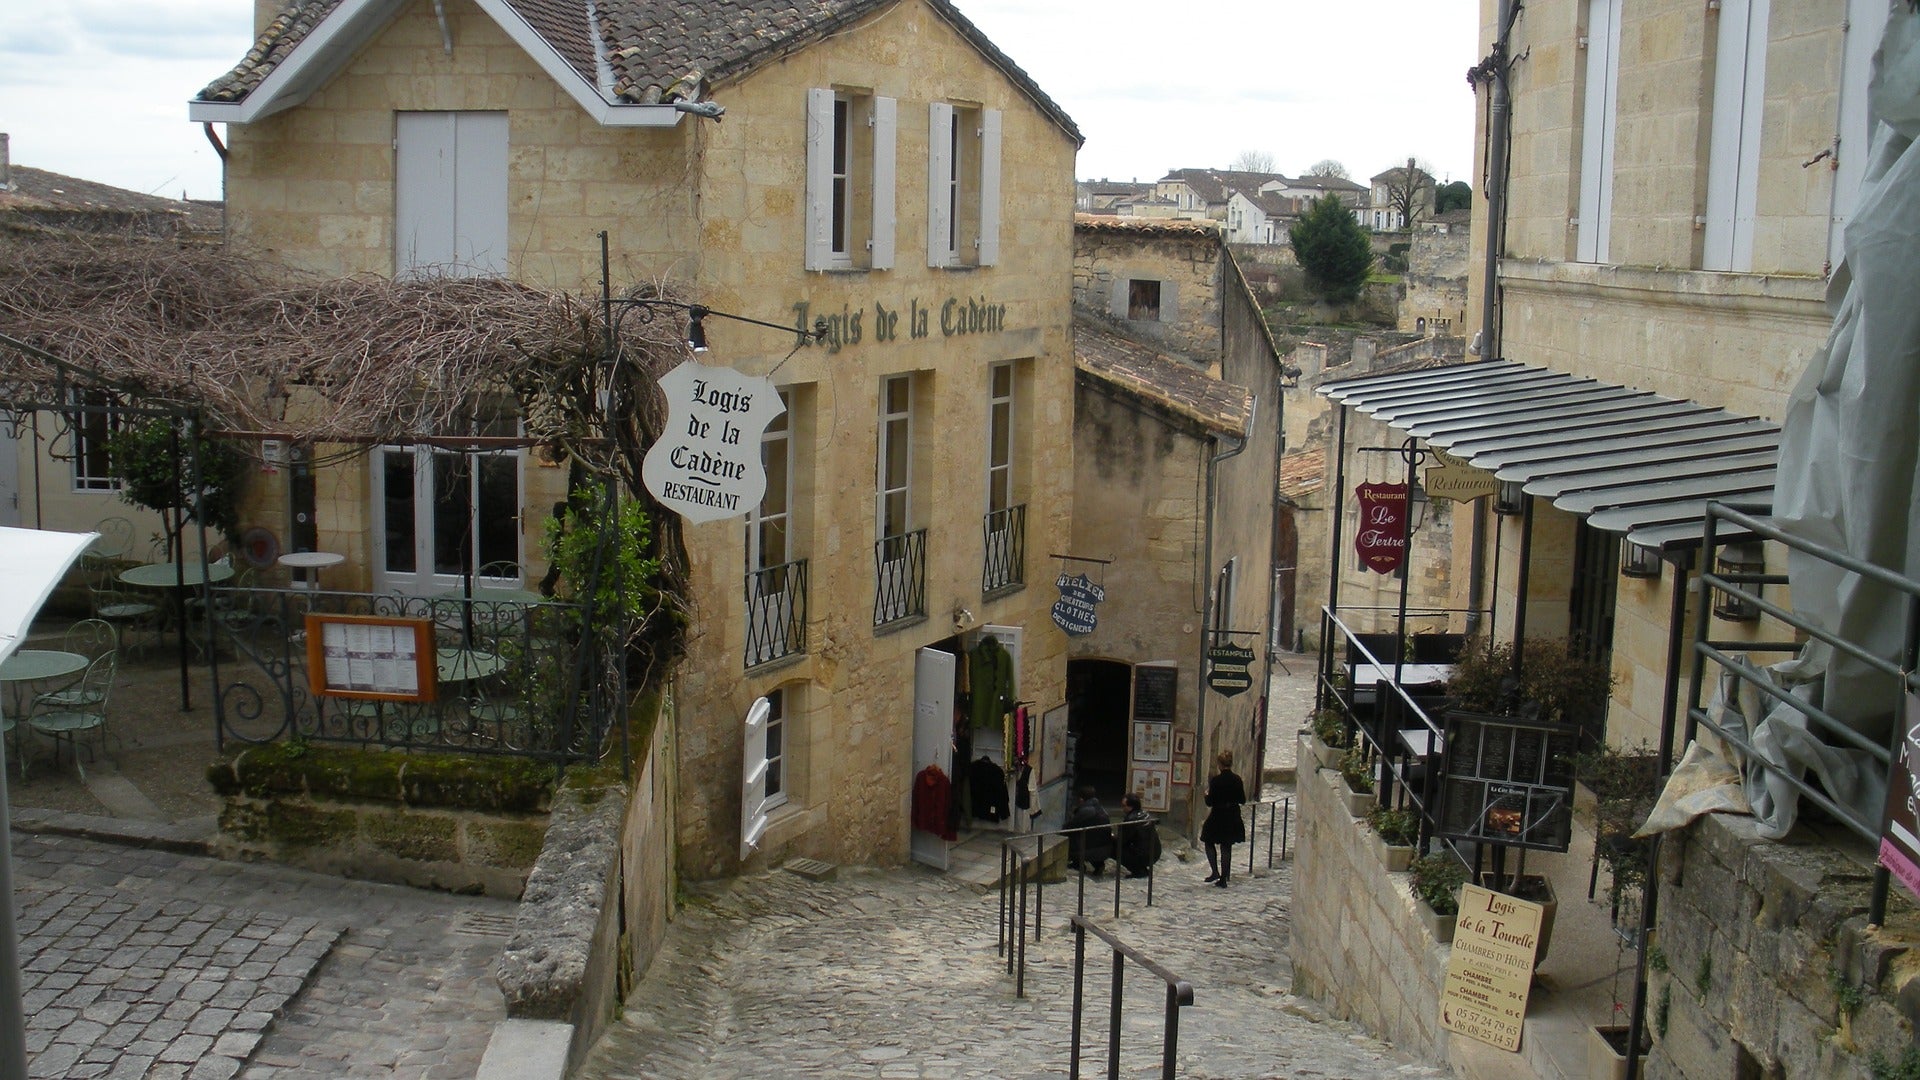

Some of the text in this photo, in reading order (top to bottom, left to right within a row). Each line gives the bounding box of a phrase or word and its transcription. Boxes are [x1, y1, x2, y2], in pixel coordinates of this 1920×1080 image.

[876, 301, 899, 342] de
[910, 297, 929, 339] la
[691, 379, 753, 413] Logis
[688, 413, 740, 445] de la
[670, 445, 746, 480] Cadène
[663, 481, 740, 510] RESTAURANT
[1364, 489, 1406, 503] Restaurant
[1370, 505, 1397, 525] Le
[1360, 529, 1404, 548] Tertre
[1052, 612, 1092, 633] DESIGNERS
[1054, 602, 1096, 624] CLOTHES
[1486, 893, 1516, 916] Logis
[1459, 915, 1534, 949] de la Tourelle
[1455, 938, 1495, 960] CHAMBRES
[1463, 970, 1492, 984] CHAMBRE
[1460, 987, 1489, 1001] CHAMBRE
[1456, 1007, 1518, 1036] 05 57 24 79 65
[1454, 1020, 1515, 1048] 06 08 25 14 51
